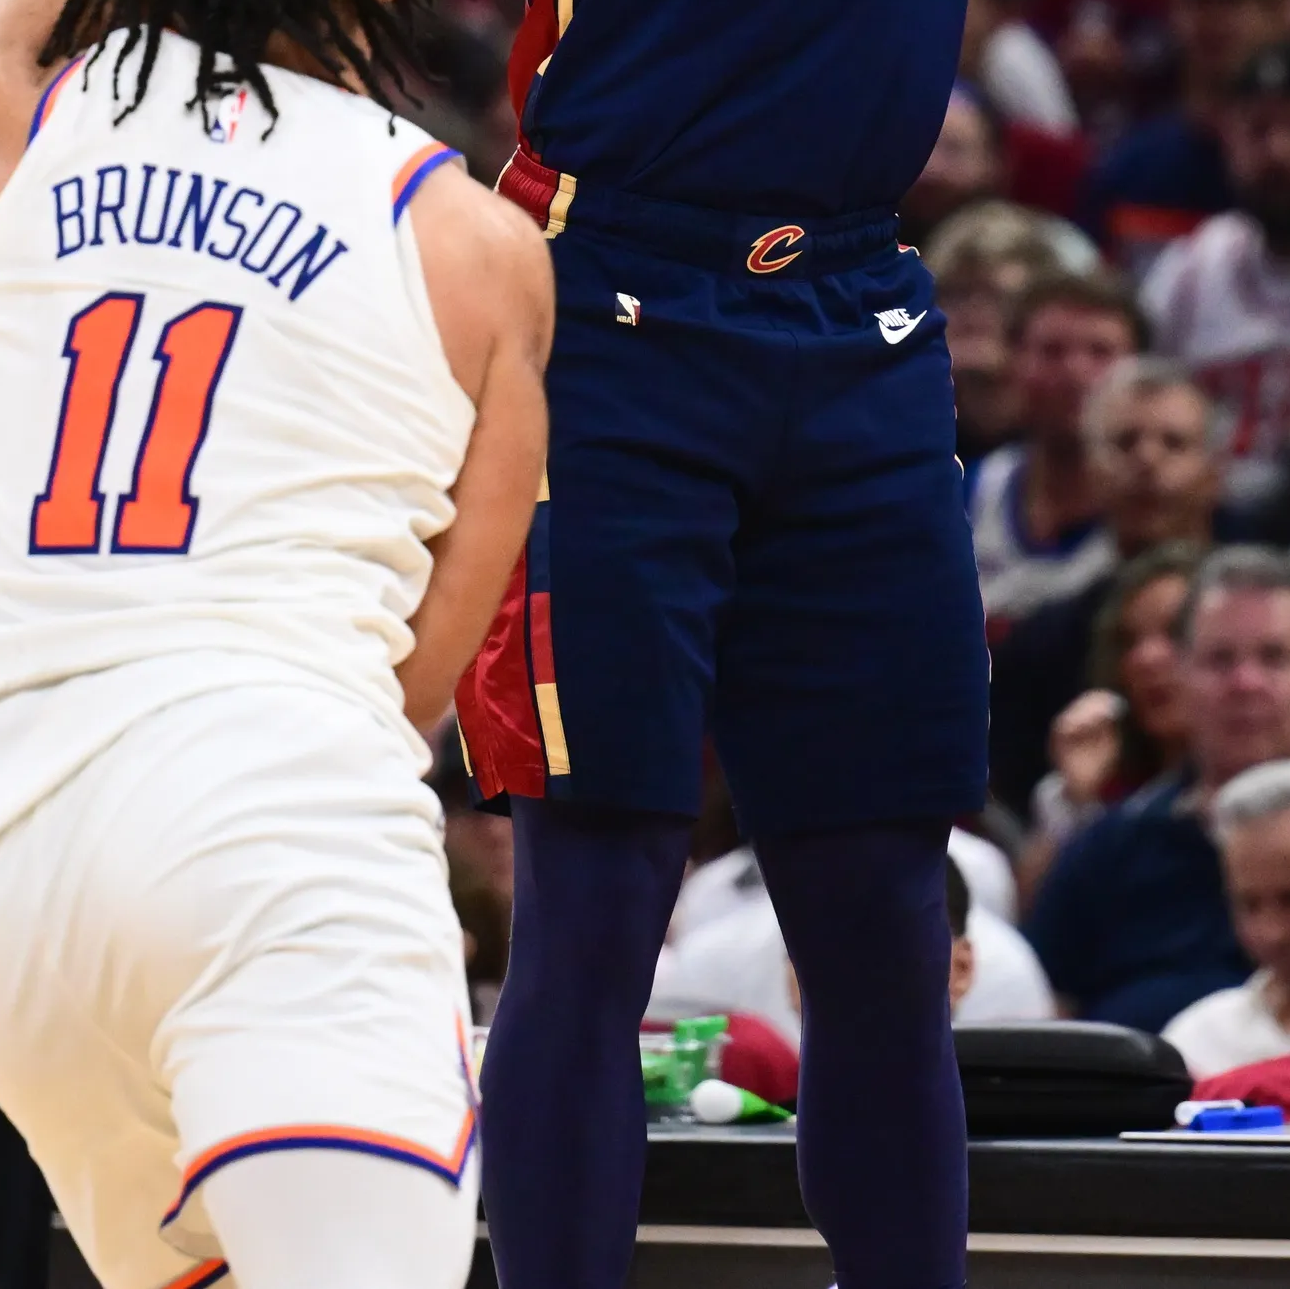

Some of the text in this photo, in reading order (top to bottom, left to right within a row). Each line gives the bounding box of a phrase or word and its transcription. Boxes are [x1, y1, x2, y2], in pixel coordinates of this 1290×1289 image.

[52, 163, 349, 303] BRUNSON
[616, 314, 632, 324] NBA
[873, 308, 911, 327] NIKE
[28, 289, 247, 556] 11
